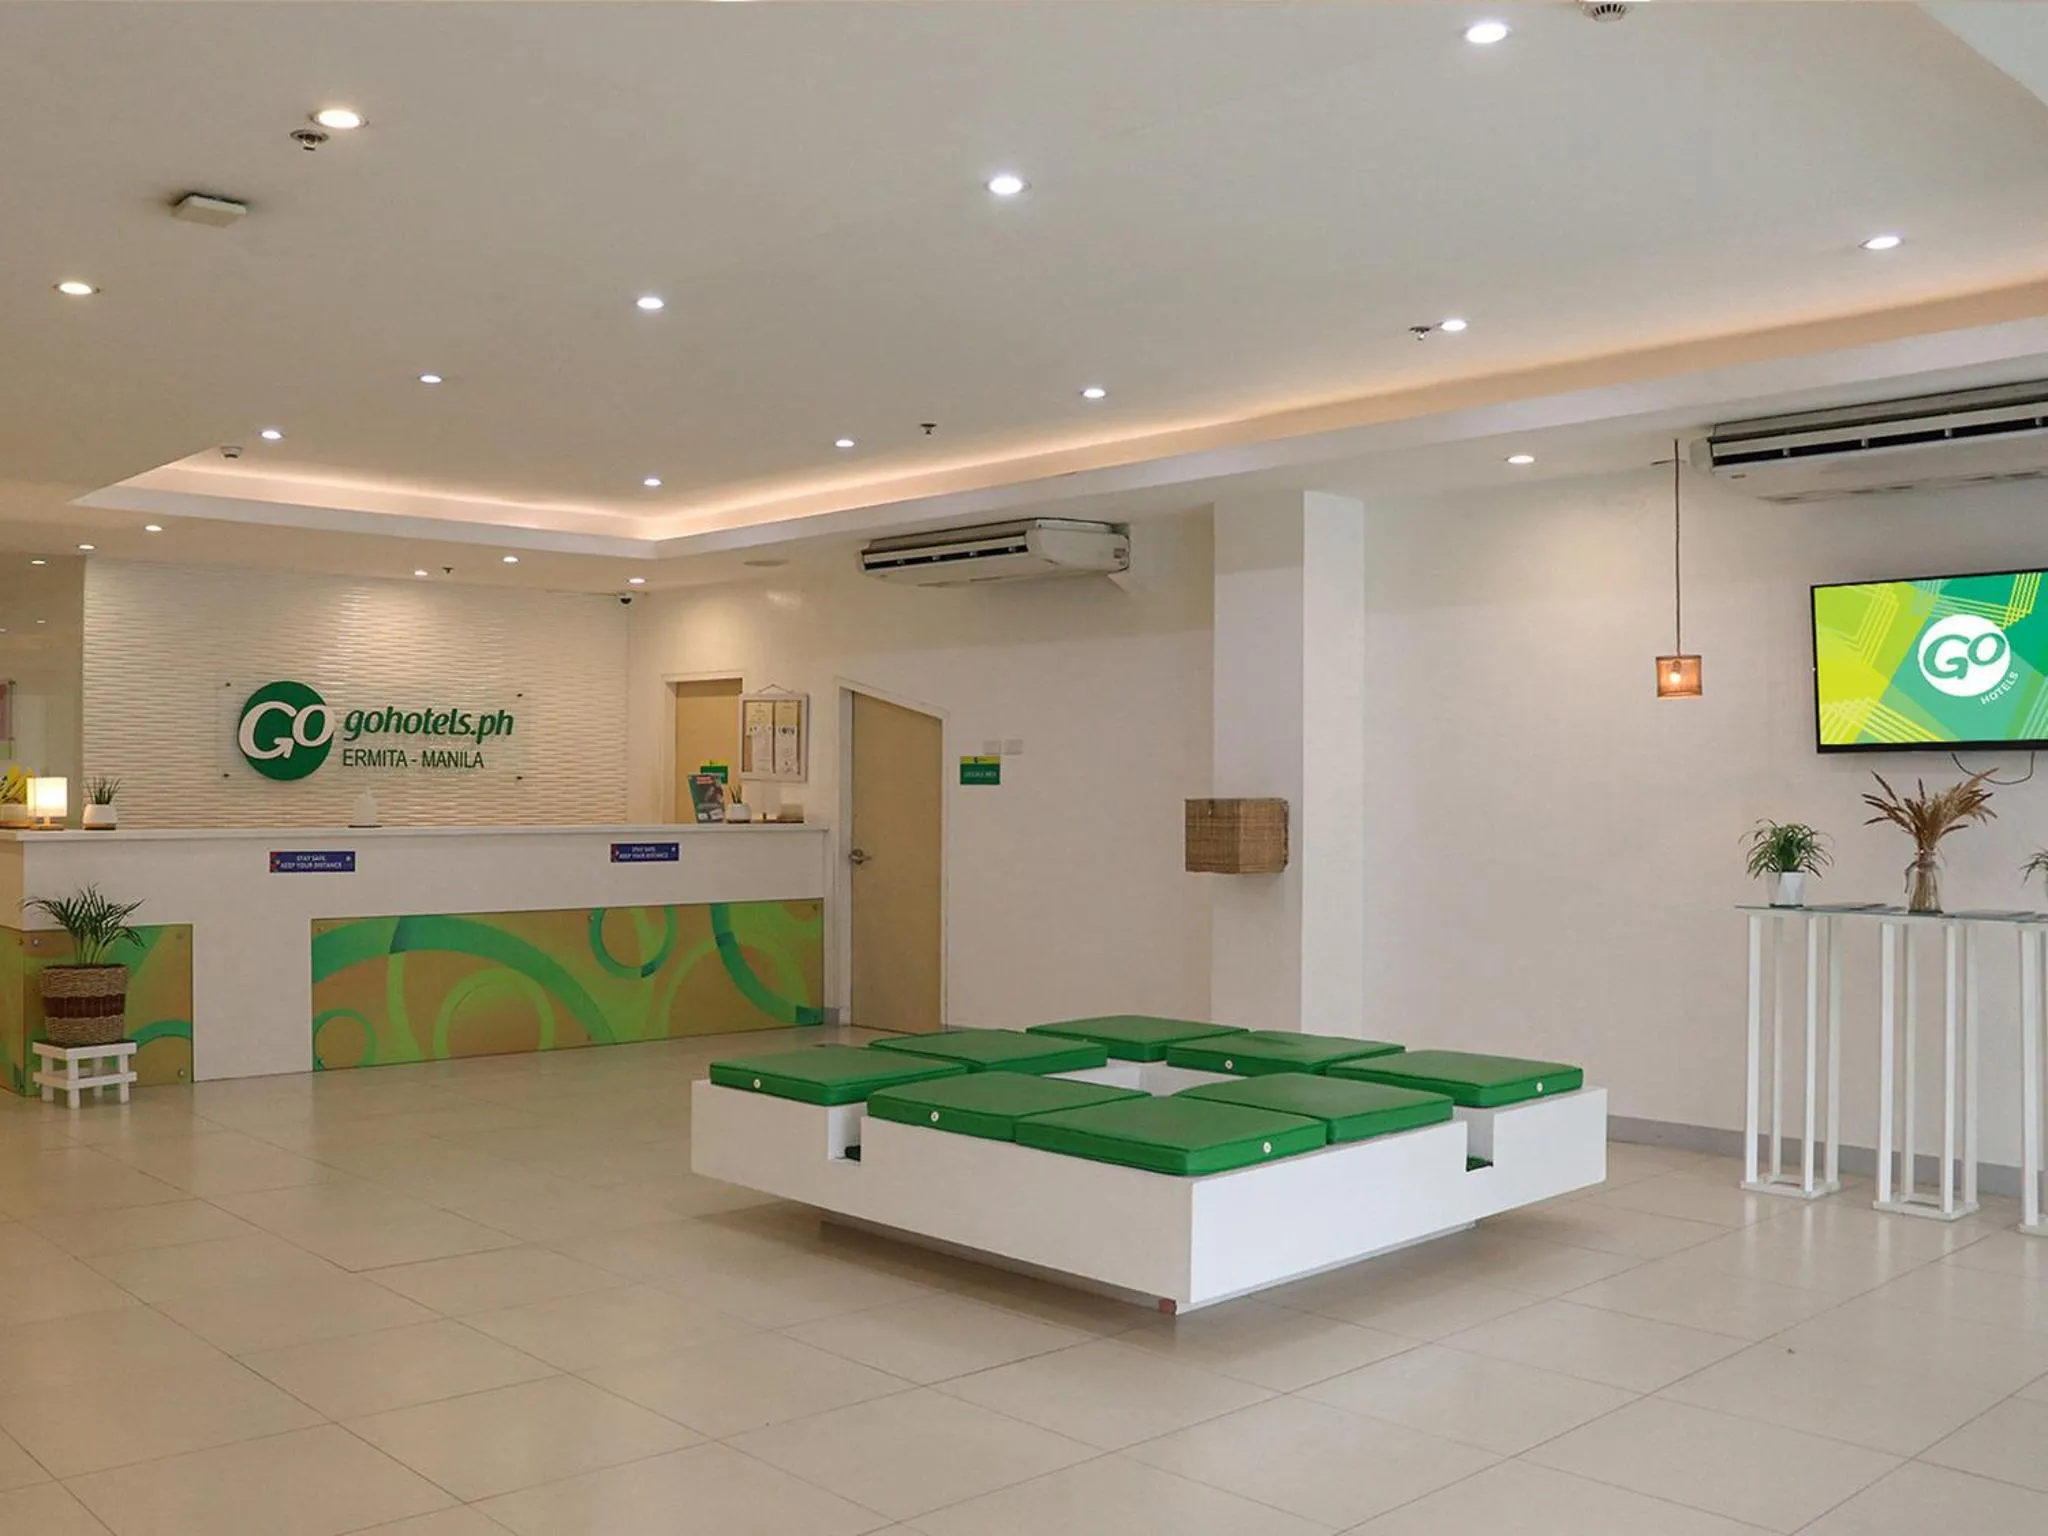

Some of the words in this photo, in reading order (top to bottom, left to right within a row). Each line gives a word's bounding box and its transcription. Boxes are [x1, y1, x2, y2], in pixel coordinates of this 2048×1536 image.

[1923, 632, 2007, 680] GO
[1980, 671, 2019, 705] HOTELS
[343, 706, 514, 744] gohotels.ph
[343, 748, 408, 767] ERMITA
[421, 750, 484, 768] MANILA
